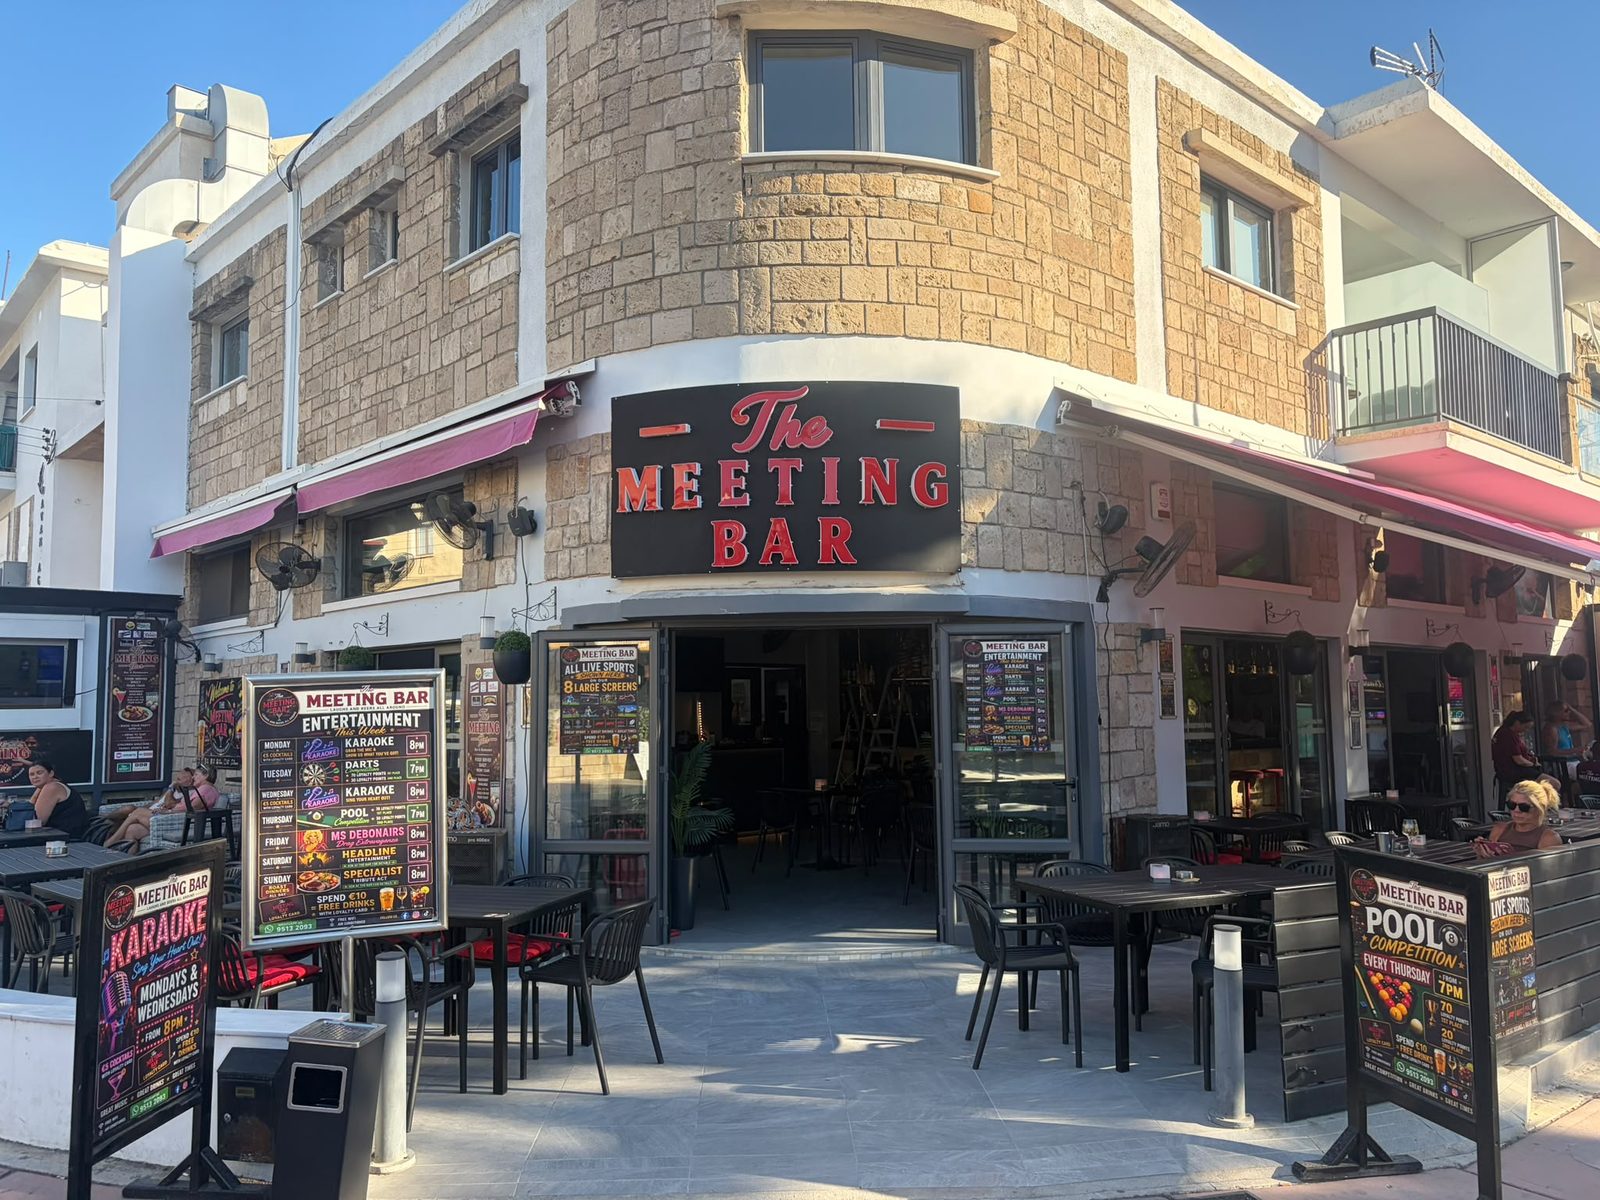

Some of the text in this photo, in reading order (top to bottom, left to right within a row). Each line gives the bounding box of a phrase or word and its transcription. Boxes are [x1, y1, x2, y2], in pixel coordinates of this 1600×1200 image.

[731, 385, 834, 453] The
[616, 457, 949, 512] MEETING
[711, 517, 857, 568] BAR
[581, 649, 635, 658] MEETING BAR
[984, 652, 1043, 661] ENTERTAINMENT
[564, 662, 635, 675] ALL LIVE SPORTS
[563, 680, 637, 694] 8 LARGE SCREENS
[263, 698, 296, 708] MEETING
[306, 691, 429, 709] MEETING BAR
[302, 712, 421, 734] ENTERTAINMENT
[468, 721, 500, 735] MEETING
[335, 726, 386, 737] This Week
[264, 740, 291, 750] MONDAY
[345, 736, 394, 748] KARAOKE
[409, 740, 425, 750] 8PM
[307, 749, 336, 760] KARAOKE
[345, 759, 380, 769] DARTS
[410, 763, 425, 774] 7PM
[263, 769, 293, 778] TUESDAY
[261, 789, 294, 799] WEDNESDAY
[345, 785, 395, 797] KARAOKE
[410, 786, 425, 797] 8PM
[307, 797, 337, 808] KARAOKE
[340, 808, 369, 819] POOL
[411, 809, 425, 819] 7PM
[262, 815, 293, 825] THURSDAY
[331, 826, 405, 841] MS DEBONAIRS
[410, 828, 425, 838] 8PM
[265, 837, 290, 847] FRIDAY
[336, 840, 355, 848] Drag
[342, 846, 397, 859] HEADLINE
[411, 848, 426, 859] 8PM
[262, 856, 293, 866] SATURDAY
[347, 855, 391, 863] ENTERTAINMENT
[343, 866, 403, 879] SPECIALIST
[411, 869, 426, 880] 8PM
[263, 874, 291, 885] SUNDAY
[1490, 871, 1529, 892] MEETING BAR
[137, 874, 208, 908] MEETING BAR
[107, 894, 133, 911] MEETING
[317, 891, 367, 904] SPEND €10
[1380, 881, 1436, 909] MEETING
[1438, 895, 1465, 916] BAR
[318, 899, 375, 911] FREE DRINKS
[1490, 896, 1530, 920] LIVE SPORTS
[110, 897, 208, 972] KARAOKE
[1365, 906, 1443, 951] POOL
[1491, 930, 1534, 958] ARGE SCREENS
[1369, 935, 1458, 969] COMPETITION
[131, 961, 149, 980] Sing
[149, 953, 167, 972] Your
[167, 941, 187, 959] Heart
[1363, 953, 1431, 985] EVERY THURSDAY
[140, 964, 198, 1004] MONDAYS &
[1442, 974, 1457, 985] FROM
[1438, 980, 1463, 1000] 7PM
[137, 981, 199, 1023] WEDNESDAYS
[1440, 1000, 1453, 1014] 70
[145, 1015, 184, 1042] FROM 8PM
[1441, 1028, 1454, 1040] 20
[175, 1032, 190, 1044] SPEND
[182, 1036, 195, 1048] FREE
[1395, 1033, 1415, 1048] SPEND
[1415, 1041, 1428, 1053] €10
[109, 1051, 133, 1069] COCKTAILS
[1400, 1044, 1433, 1064] FREE DRINKS
